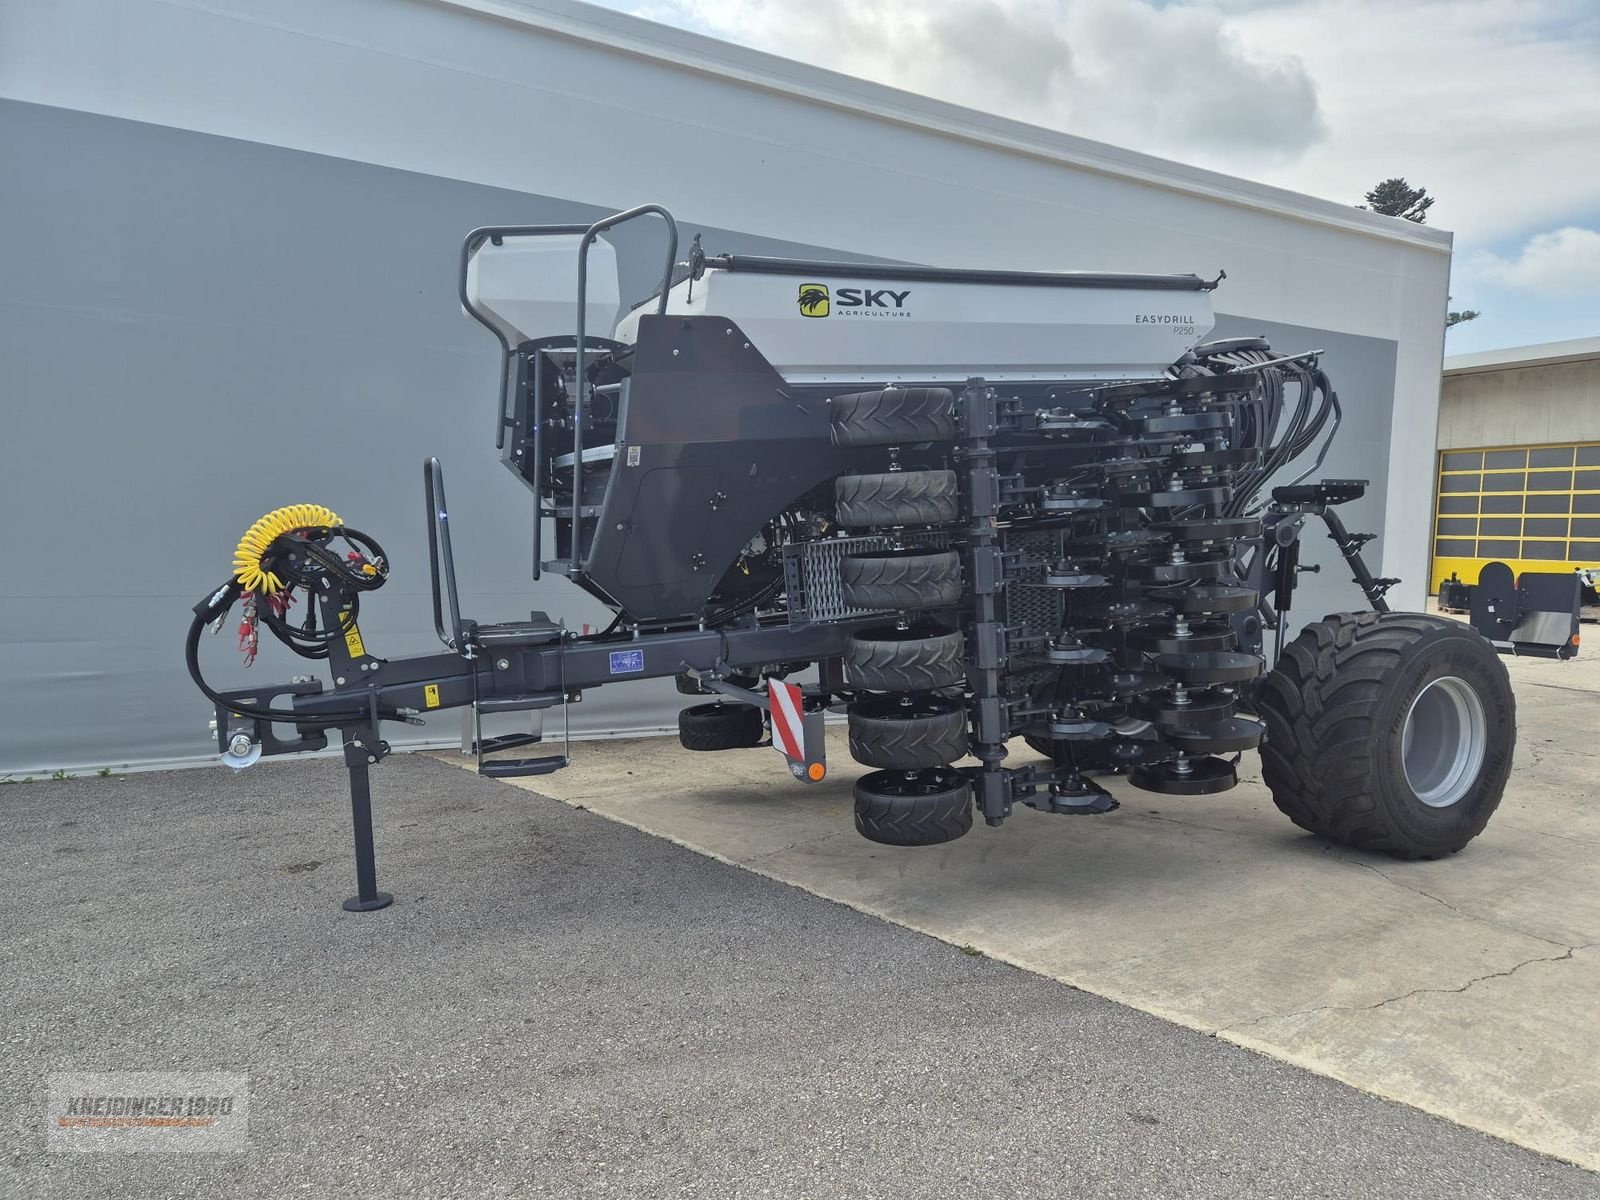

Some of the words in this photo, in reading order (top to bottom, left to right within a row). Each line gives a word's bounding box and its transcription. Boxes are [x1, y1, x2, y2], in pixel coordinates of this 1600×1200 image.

[836, 288, 911, 308] SKY
[1135, 314, 1194, 324] EASYDRILL
[1173, 326, 1194, 335] P250
